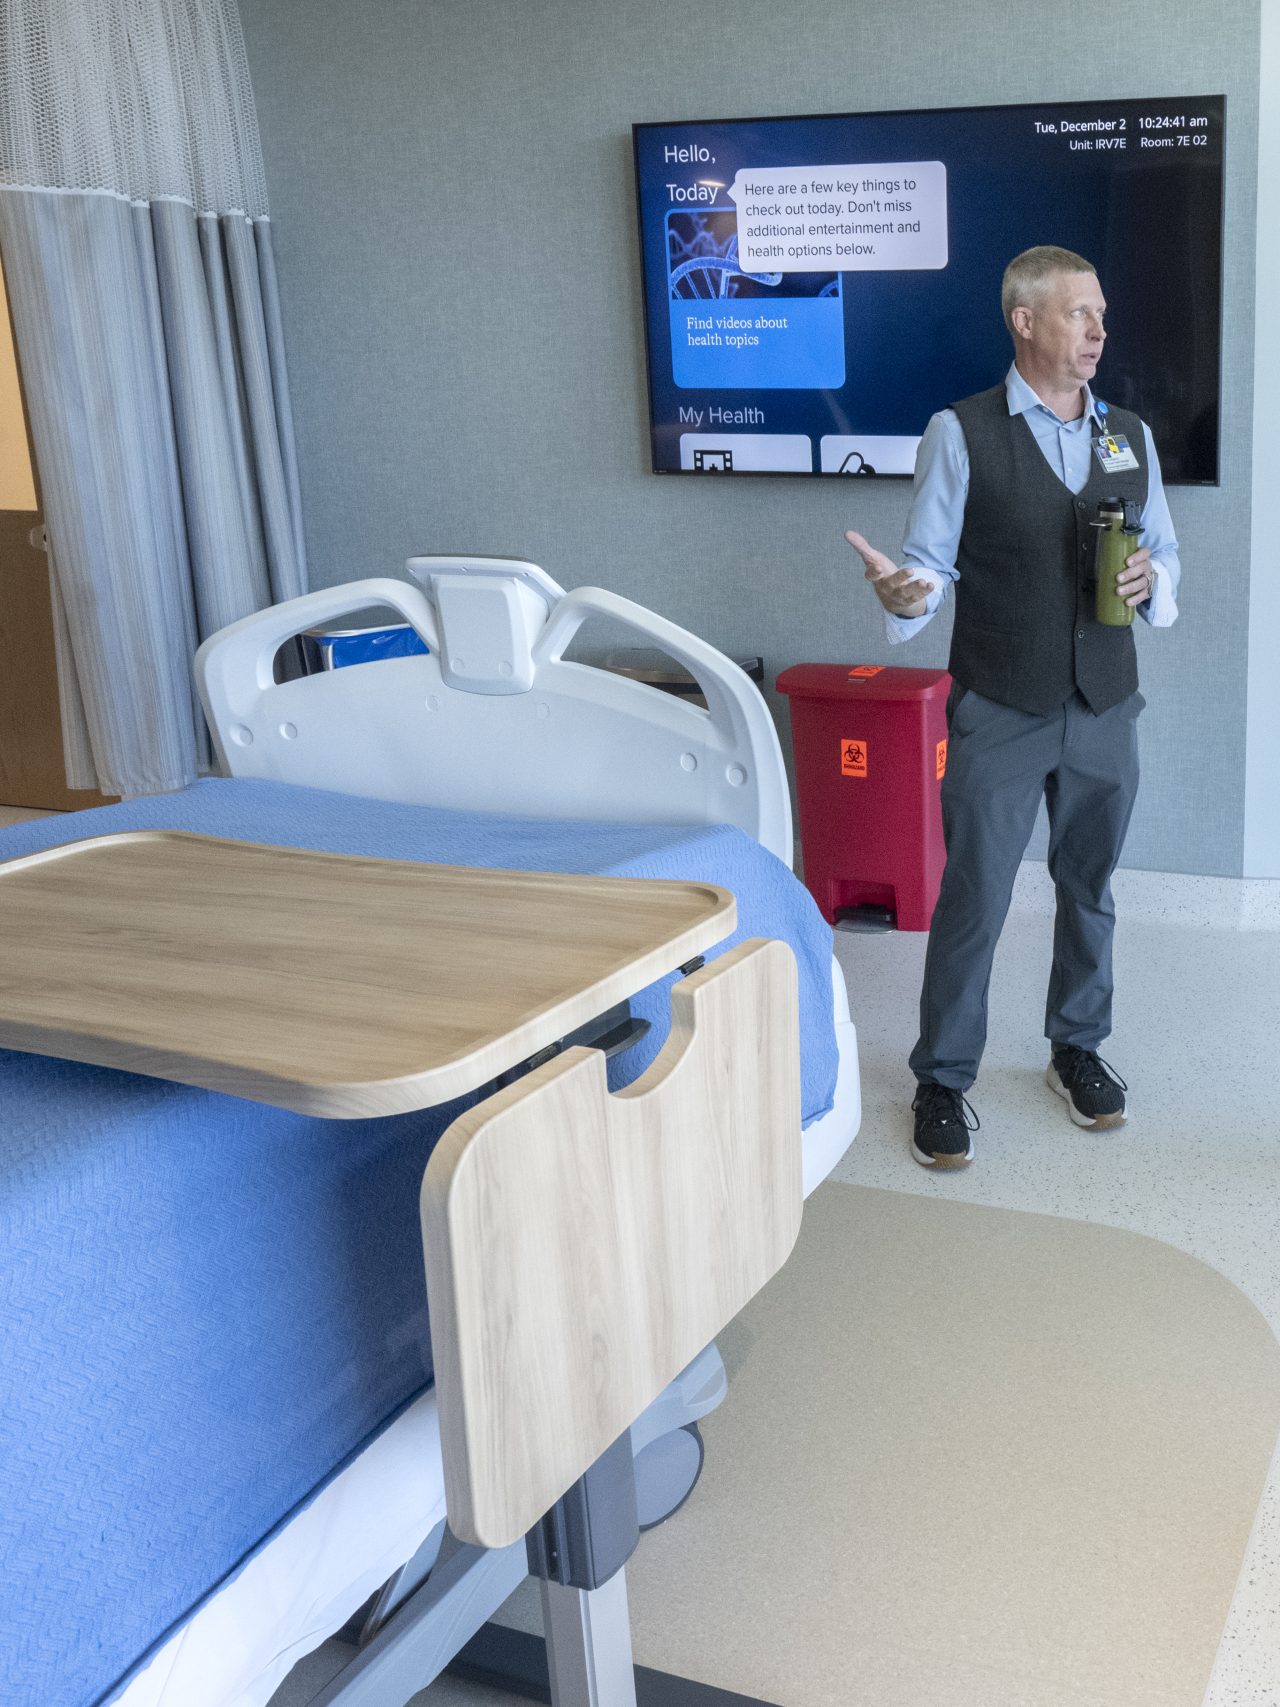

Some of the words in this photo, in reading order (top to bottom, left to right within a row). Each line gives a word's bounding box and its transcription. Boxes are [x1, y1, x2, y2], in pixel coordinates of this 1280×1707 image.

[1035, 121, 1057, 134] Tue,
[1060, 119, 1116, 132] December
[1119, 119, 1126, 130] 2
[1138, 116, 1185, 129] 10:24:41
[1190, 116, 1208, 127] am
[1069, 139, 1093, 150] Unit:
[1095, 138, 1127, 149] IRV7E
[1141, 137, 1174, 148] Room:
[1176, 135, 1190, 146] 7E
[1192, 135, 1207, 146] 02
[664, 144, 716, 164] Hello,
[666, 183, 718, 204] Today
[744, 182, 774, 196] Here
[777, 184, 797, 195] are
[800, 185, 808, 194] a
[810, 181, 833, 193] few
[836, 180, 858, 195] key
[861, 179, 900, 195] things
[903, 179, 916, 190] to
[745, 203, 781, 216] check
[784, 203, 804, 215] out
[807, 201, 844, 217] today.
[848, 199, 880, 213] Don't
[884, 199, 912, 212] miss
[746, 224, 805, 238] additional
[808, 222, 894, 236] entertainment
[897, 220, 920, 233] and
[747, 244, 784, 257] health
[788, 244, 832, 258] options
[835, 242, 876, 256] below.
[687, 317, 712, 329] Find
[716, 317, 753, 329] videos
[755, 316, 788, 328] about
[687, 333, 722, 346] health
[725, 333, 759, 348] topics
[679, 407, 703, 427] My
[709, 407, 765, 424] Health
